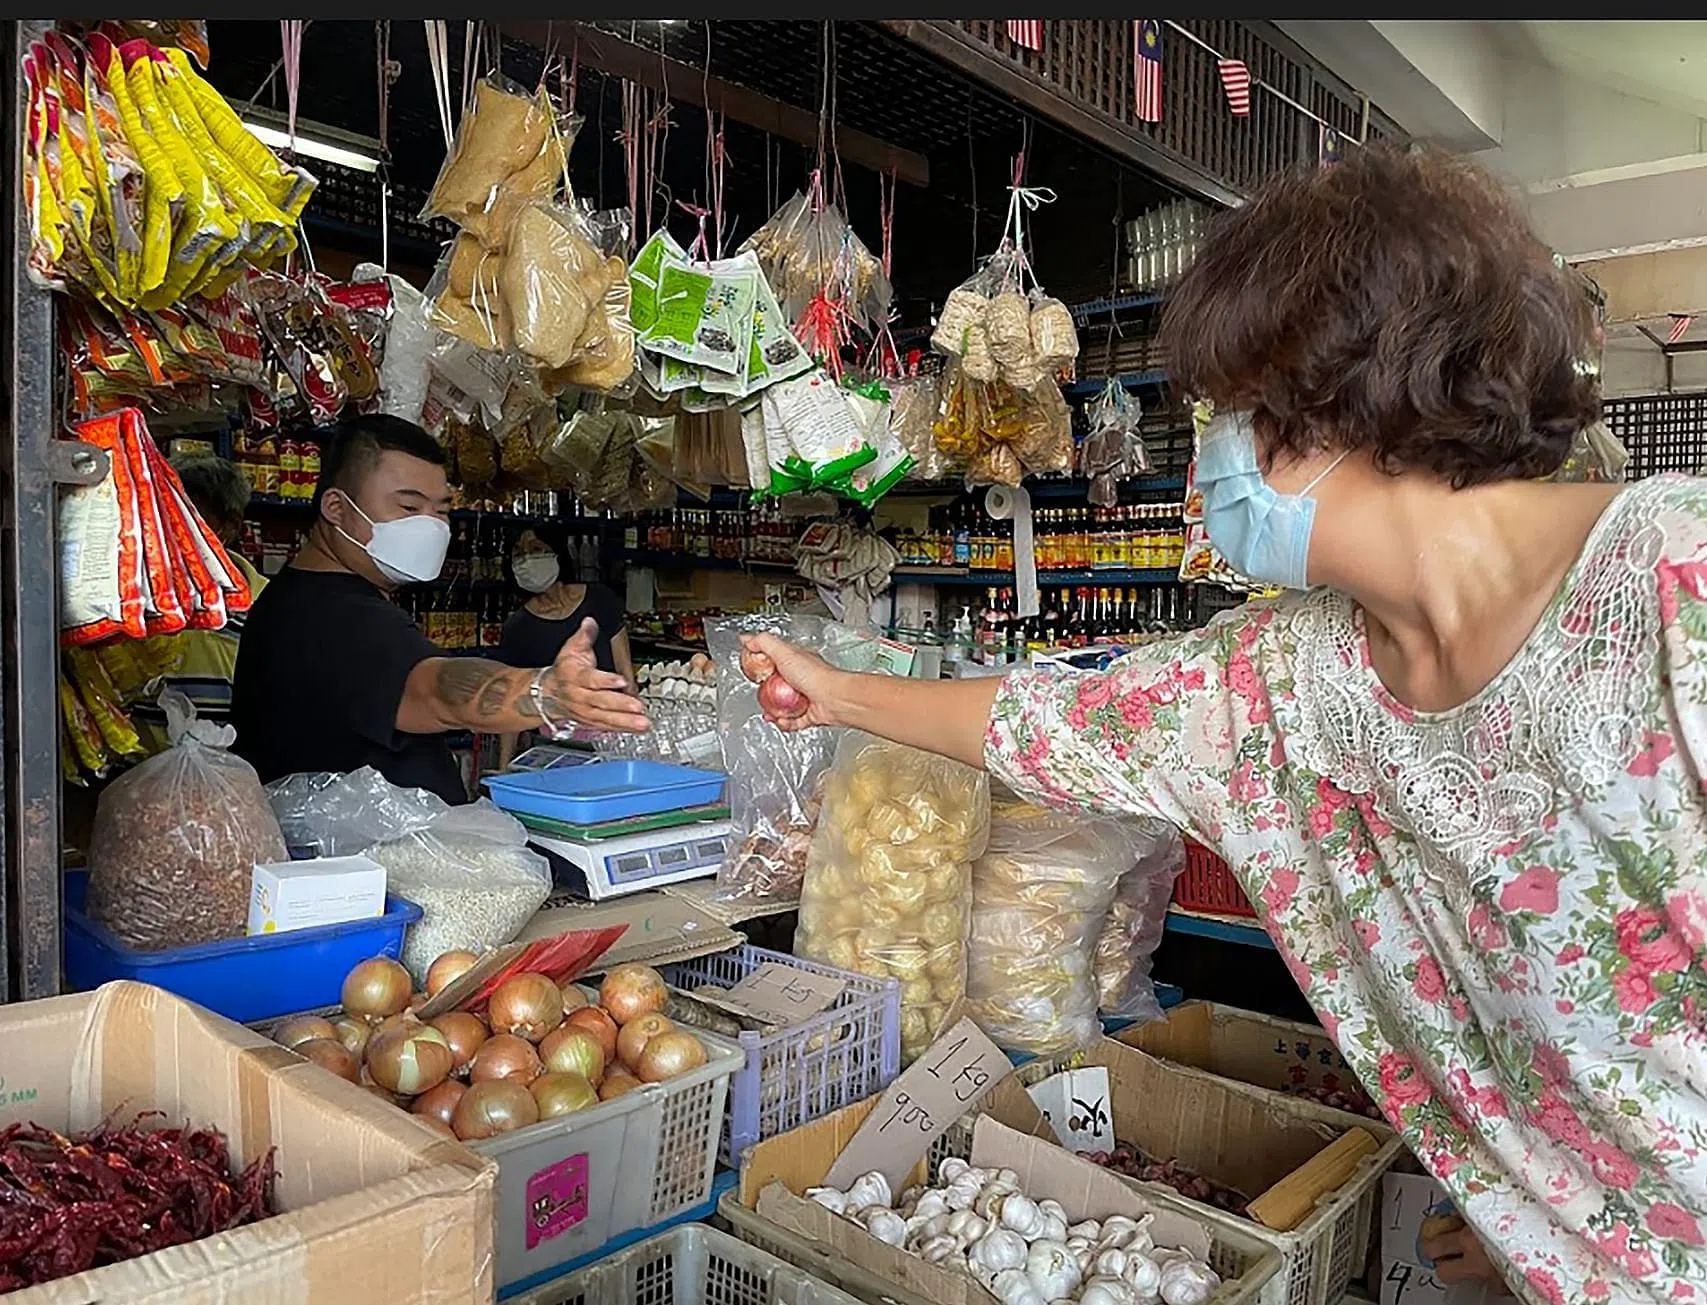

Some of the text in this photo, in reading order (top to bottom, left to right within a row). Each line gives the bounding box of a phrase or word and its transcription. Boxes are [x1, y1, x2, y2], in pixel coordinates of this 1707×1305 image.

[746, 968, 775, 990] 1
[926, 1036, 969, 1079] 1
[879, 1091, 935, 1132] 9.00
[1389, 1186, 1403, 1231] 1
